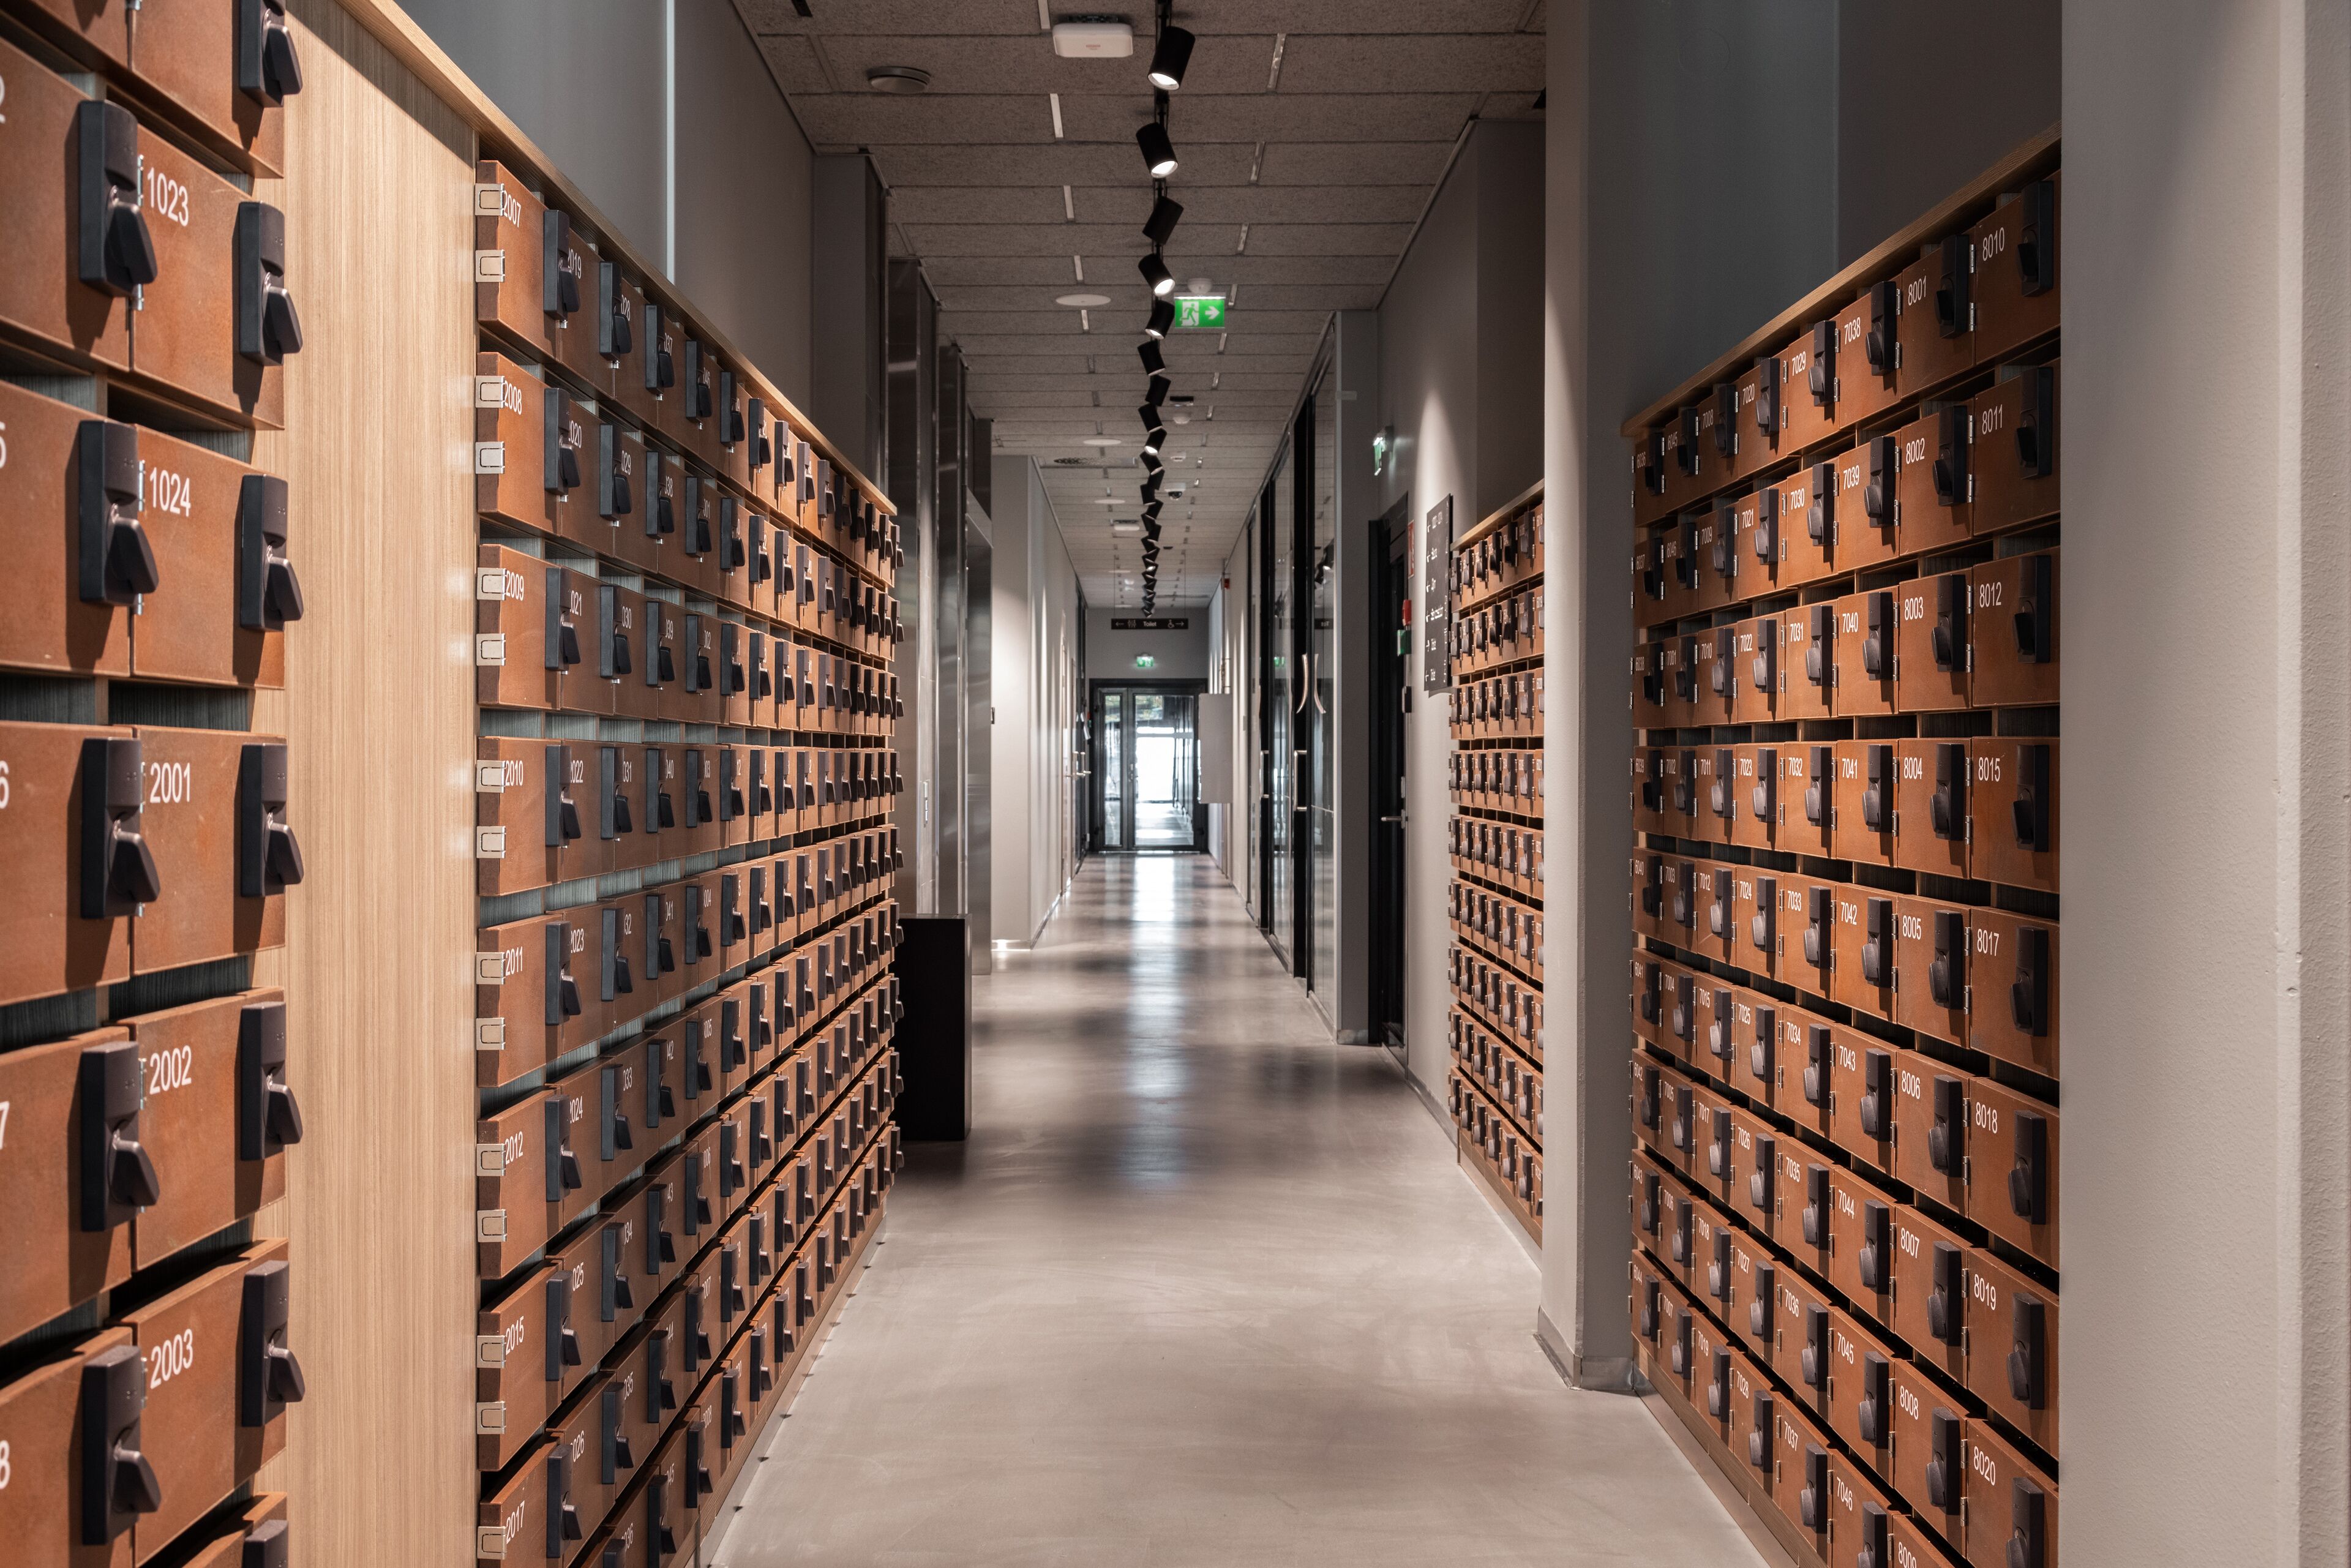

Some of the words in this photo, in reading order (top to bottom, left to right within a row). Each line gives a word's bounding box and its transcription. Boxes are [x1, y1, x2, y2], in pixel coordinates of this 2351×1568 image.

[148, 168, 189, 227] 1023
[504, 190, 521, 227] 2007
[1983, 227, 2004, 261] 8010
[1908, 276, 1925, 306] 8001
[621, 294, 630, 321] 028
[1845, 317, 1860, 344] 7038
[1792, 351, 1805, 376] 7029
[504, 380, 522, 415] 2008
[1743, 383, 1755, 405] 7020
[1703, 410, 1713, 429] 7008
[1982, 404, 2002, 434] 8011
[569, 421, 582, 448] 020
[1668, 432, 1678, 450] 6045
[621, 451, 631, 475] 029
[1906, 438, 1924, 464] 8002
[1843, 465, 1859, 490] 7039
[150, 468, 190, 517] 1024
[1791, 488, 1804, 509] 7030
[1742, 509, 1753, 528] 7021
[1702, 526, 1712, 544] 7009
[506, 571, 524, 601] 2009
[1980, 582, 2001, 607] 8012
[570, 590, 581, 616] 021
[1905, 597, 1923, 620] 8003
[623, 606, 631, 629] 030
[1843, 612, 1858, 632] 7040
[1741, 634, 1752, 651] 7022
[1790, 622, 1803, 642] 7031
[1701, 643, 1712, 659] 7010
[505, 760, 523, 786] 2010
[1667, 759, 1676, 774] 7002
[1701, 759, 1711, 775] 7011
[1741, 759, 1752, 776] 7023
[1789, 757, 1802, 776] 7032
[1842, 759, 1857, 779] 7041
[1904, 757, 1922, 779] 8004
[1979, 757, 2000, 782] 8015
[150, 762, 190, 803] 2001
[1666, 866, 1675, 883] 7003
[1700, 873, 1710, 891] 7012
[1740, 881, 1752, 900] 7024
[1788, 891, 1801, 911] 7033
[1841, 902, 1857, 925] 7042
[1903, 915, 1921, 940] 8005
[1978, 929, 1999, 956] 8017
[506, 947, 522, 976] 2011
[1665, 974, 1674, 992] 7004
[1700, 988, 1710, 1008] 7015
[1739, 1003, 1750, 1024] 7025
[1787, 1022, 1801, 1045] 7034
[150, 1045, 191, 1094] 2002
[1840, 1046, 1855, 1071] 7043
[623, 1067, 632, 1091] 033
[1665, 1081, 1674, 1101] 7005
[1902, 1070, 1920, 1099] 8006
[1699, 1102, 1709, 1123] 7017
[1976, 1102, 1997, 1133] 8018
[504, 1131, 523, 1165] 2012
[1738, 1127, 1750, 1150] 7026
[1787, 1158, 1800, 1182] 7035
[1839, 1190, 1854, 1219] 7044
[1699, 1217, 1709, 1240] 7018
[1901, 1228, 1919, 1258] 8007
[1738, 1249, 1749, 1274] 7027
[572, 1262, 583, 1291] 025
[1785, 1289, 1799, 1317] 7036
[1974, 1274, 1996, 1310] 8019
[1664, 1296, 1673, 1318] 7007
[505, 1316, 523, 1355] 2015
[1698, 1330, 1708, 1356] 7019
[1838, 1332, 1853, 1364] 7045
[151, 1329, 193, 1389] 2003
[1737, 1371, 1749, 1398] 7028
[1900, 1386, 1918, 1420] 8008
[571, 1430, 584, 1462] 026
[1785, 1421, 1798, 1450] 7037
[1974, 1446, 1995, 1485] 8020
[1837, 1477, 1852, 1510] 7046
[506, 1501, 525, 1544] 2017
